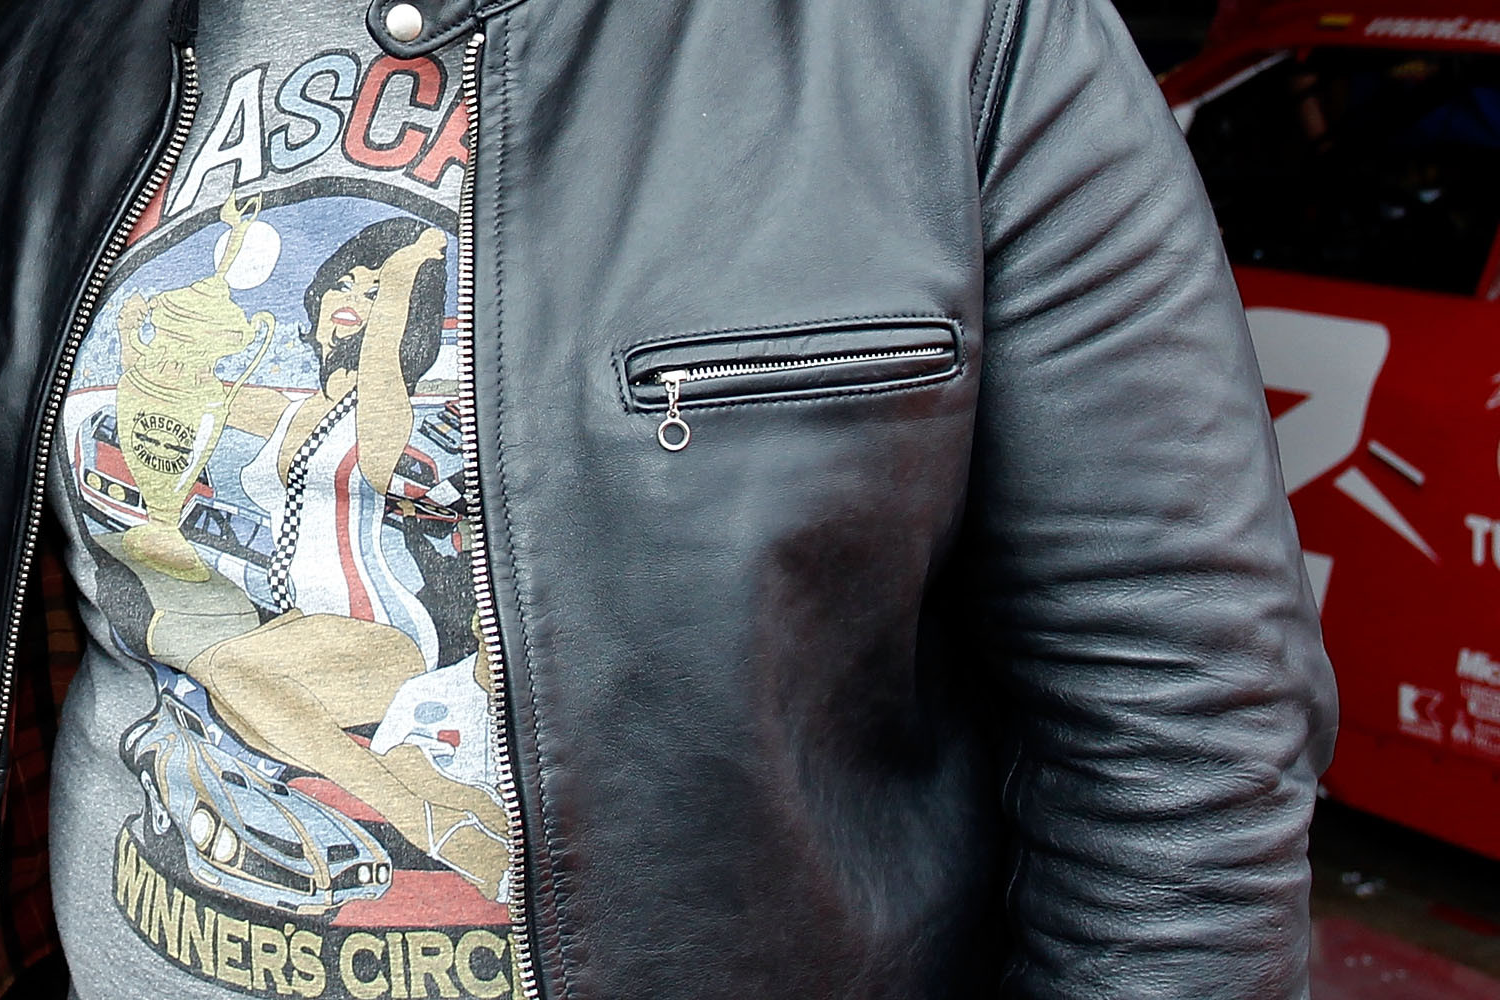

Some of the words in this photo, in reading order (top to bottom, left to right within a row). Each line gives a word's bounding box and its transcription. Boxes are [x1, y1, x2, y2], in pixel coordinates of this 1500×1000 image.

[130, 50, 472, 246] ASCA
[134, 443, 190, 474] SANCTIONED
[140, 415, 188, 443] NASCAR
[116, 826, 327, 998] WINNER'S
